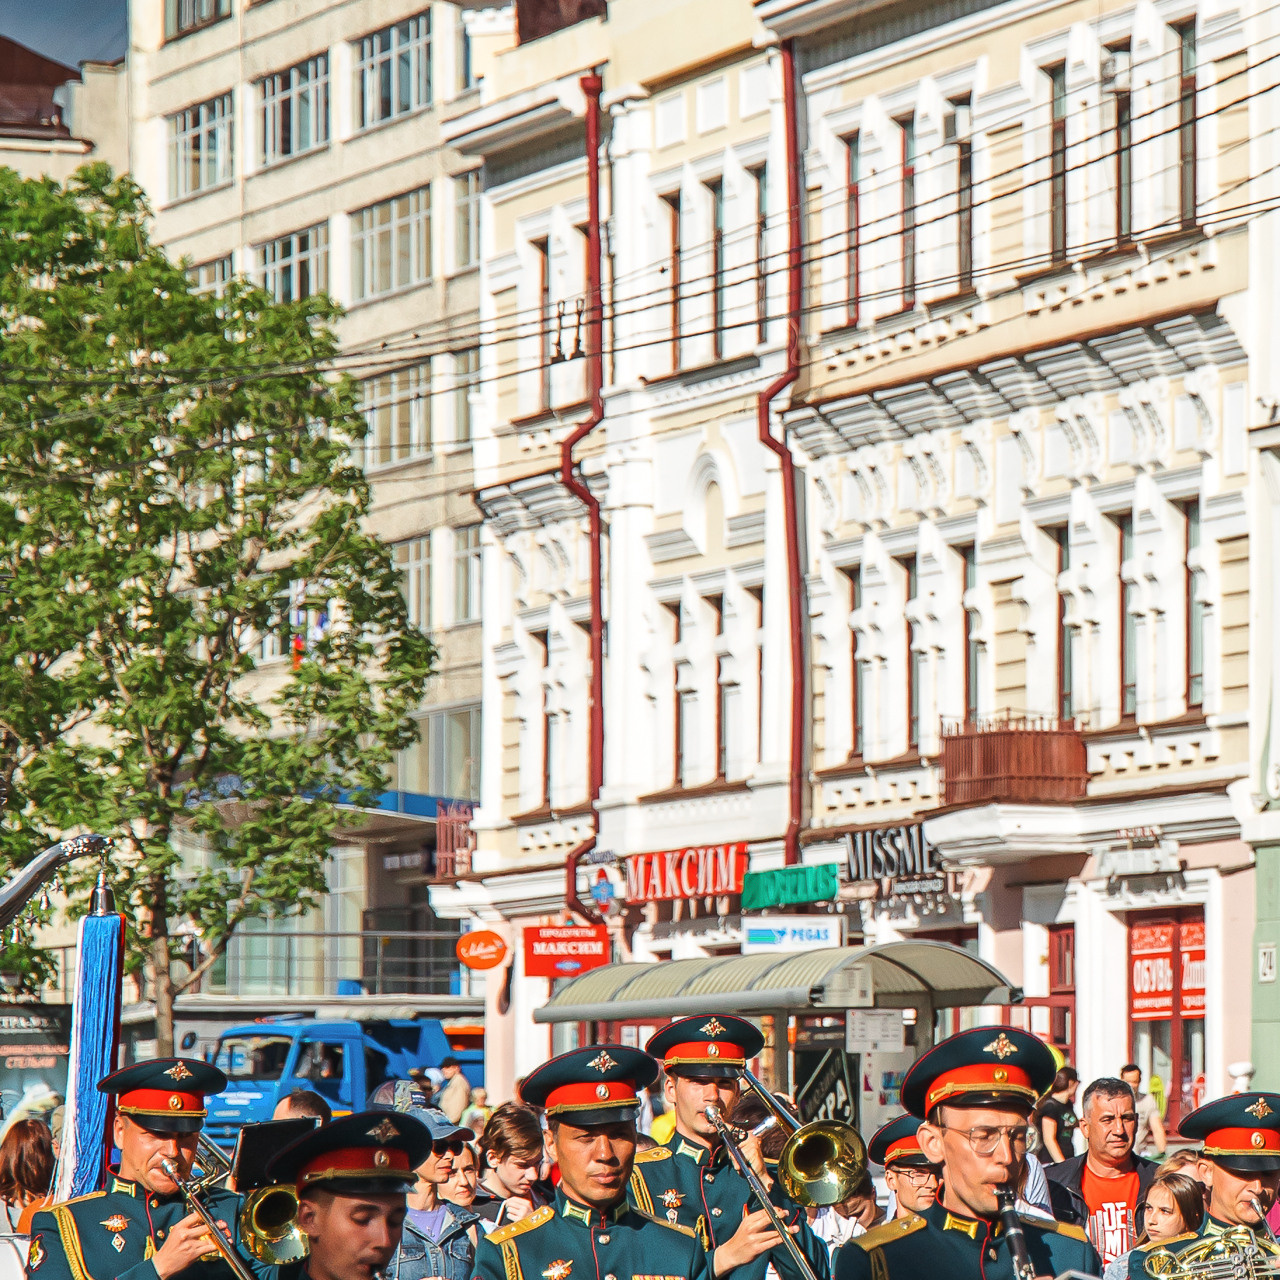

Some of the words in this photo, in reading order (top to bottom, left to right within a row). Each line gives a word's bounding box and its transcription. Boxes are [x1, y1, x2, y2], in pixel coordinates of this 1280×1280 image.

[626, 844, 737, 902] МАКСИМ
[791, 928, 829, 941] PEGAS
[533, 941, 603, 955] МАКСИМ
[1102, 1201, 1127, 1231] DE
